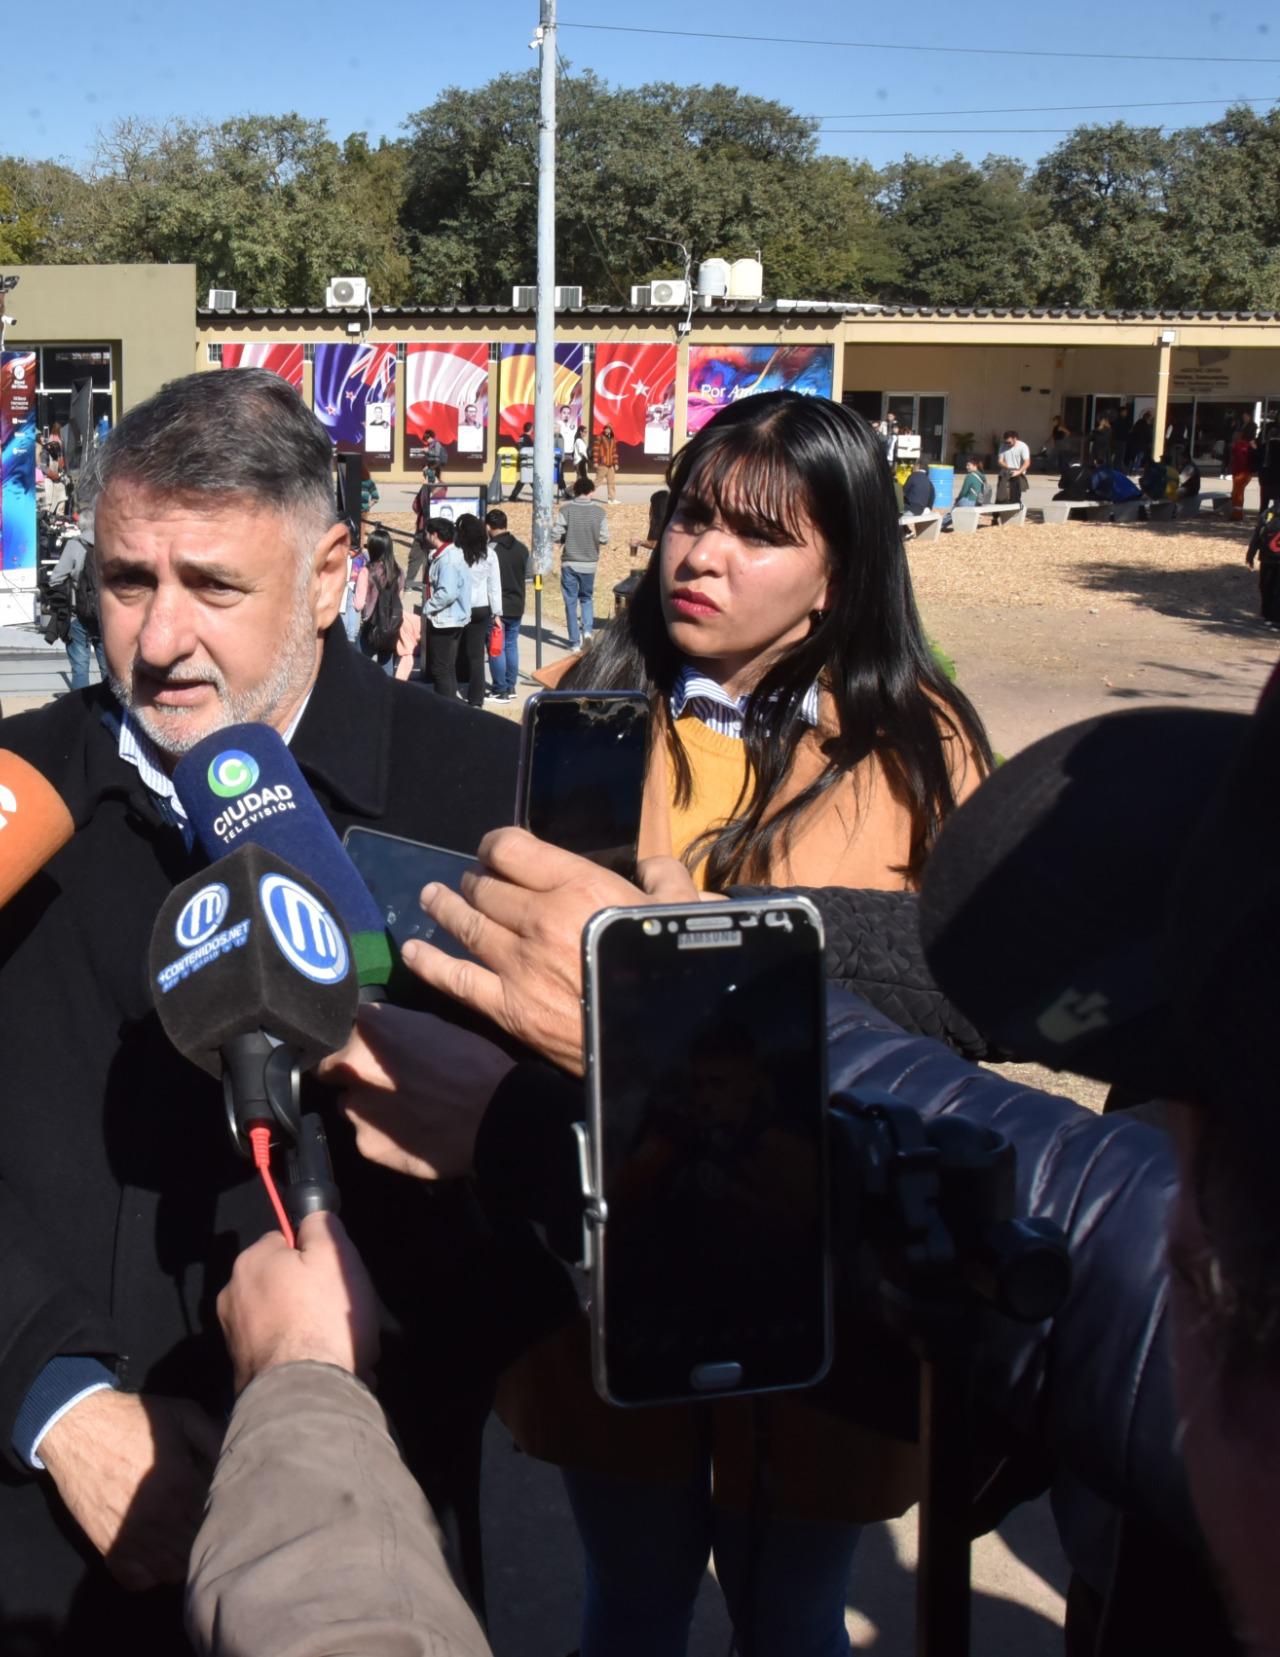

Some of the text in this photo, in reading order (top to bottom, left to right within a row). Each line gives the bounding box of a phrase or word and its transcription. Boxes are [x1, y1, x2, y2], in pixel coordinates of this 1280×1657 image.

[701, 384, 726, 398] Por
[213, 785, 293, 836] CIUDAD
[223, 801, 297, 844] TELEVISIÓN
[678, 931, 738, 945] SAMSUNG
